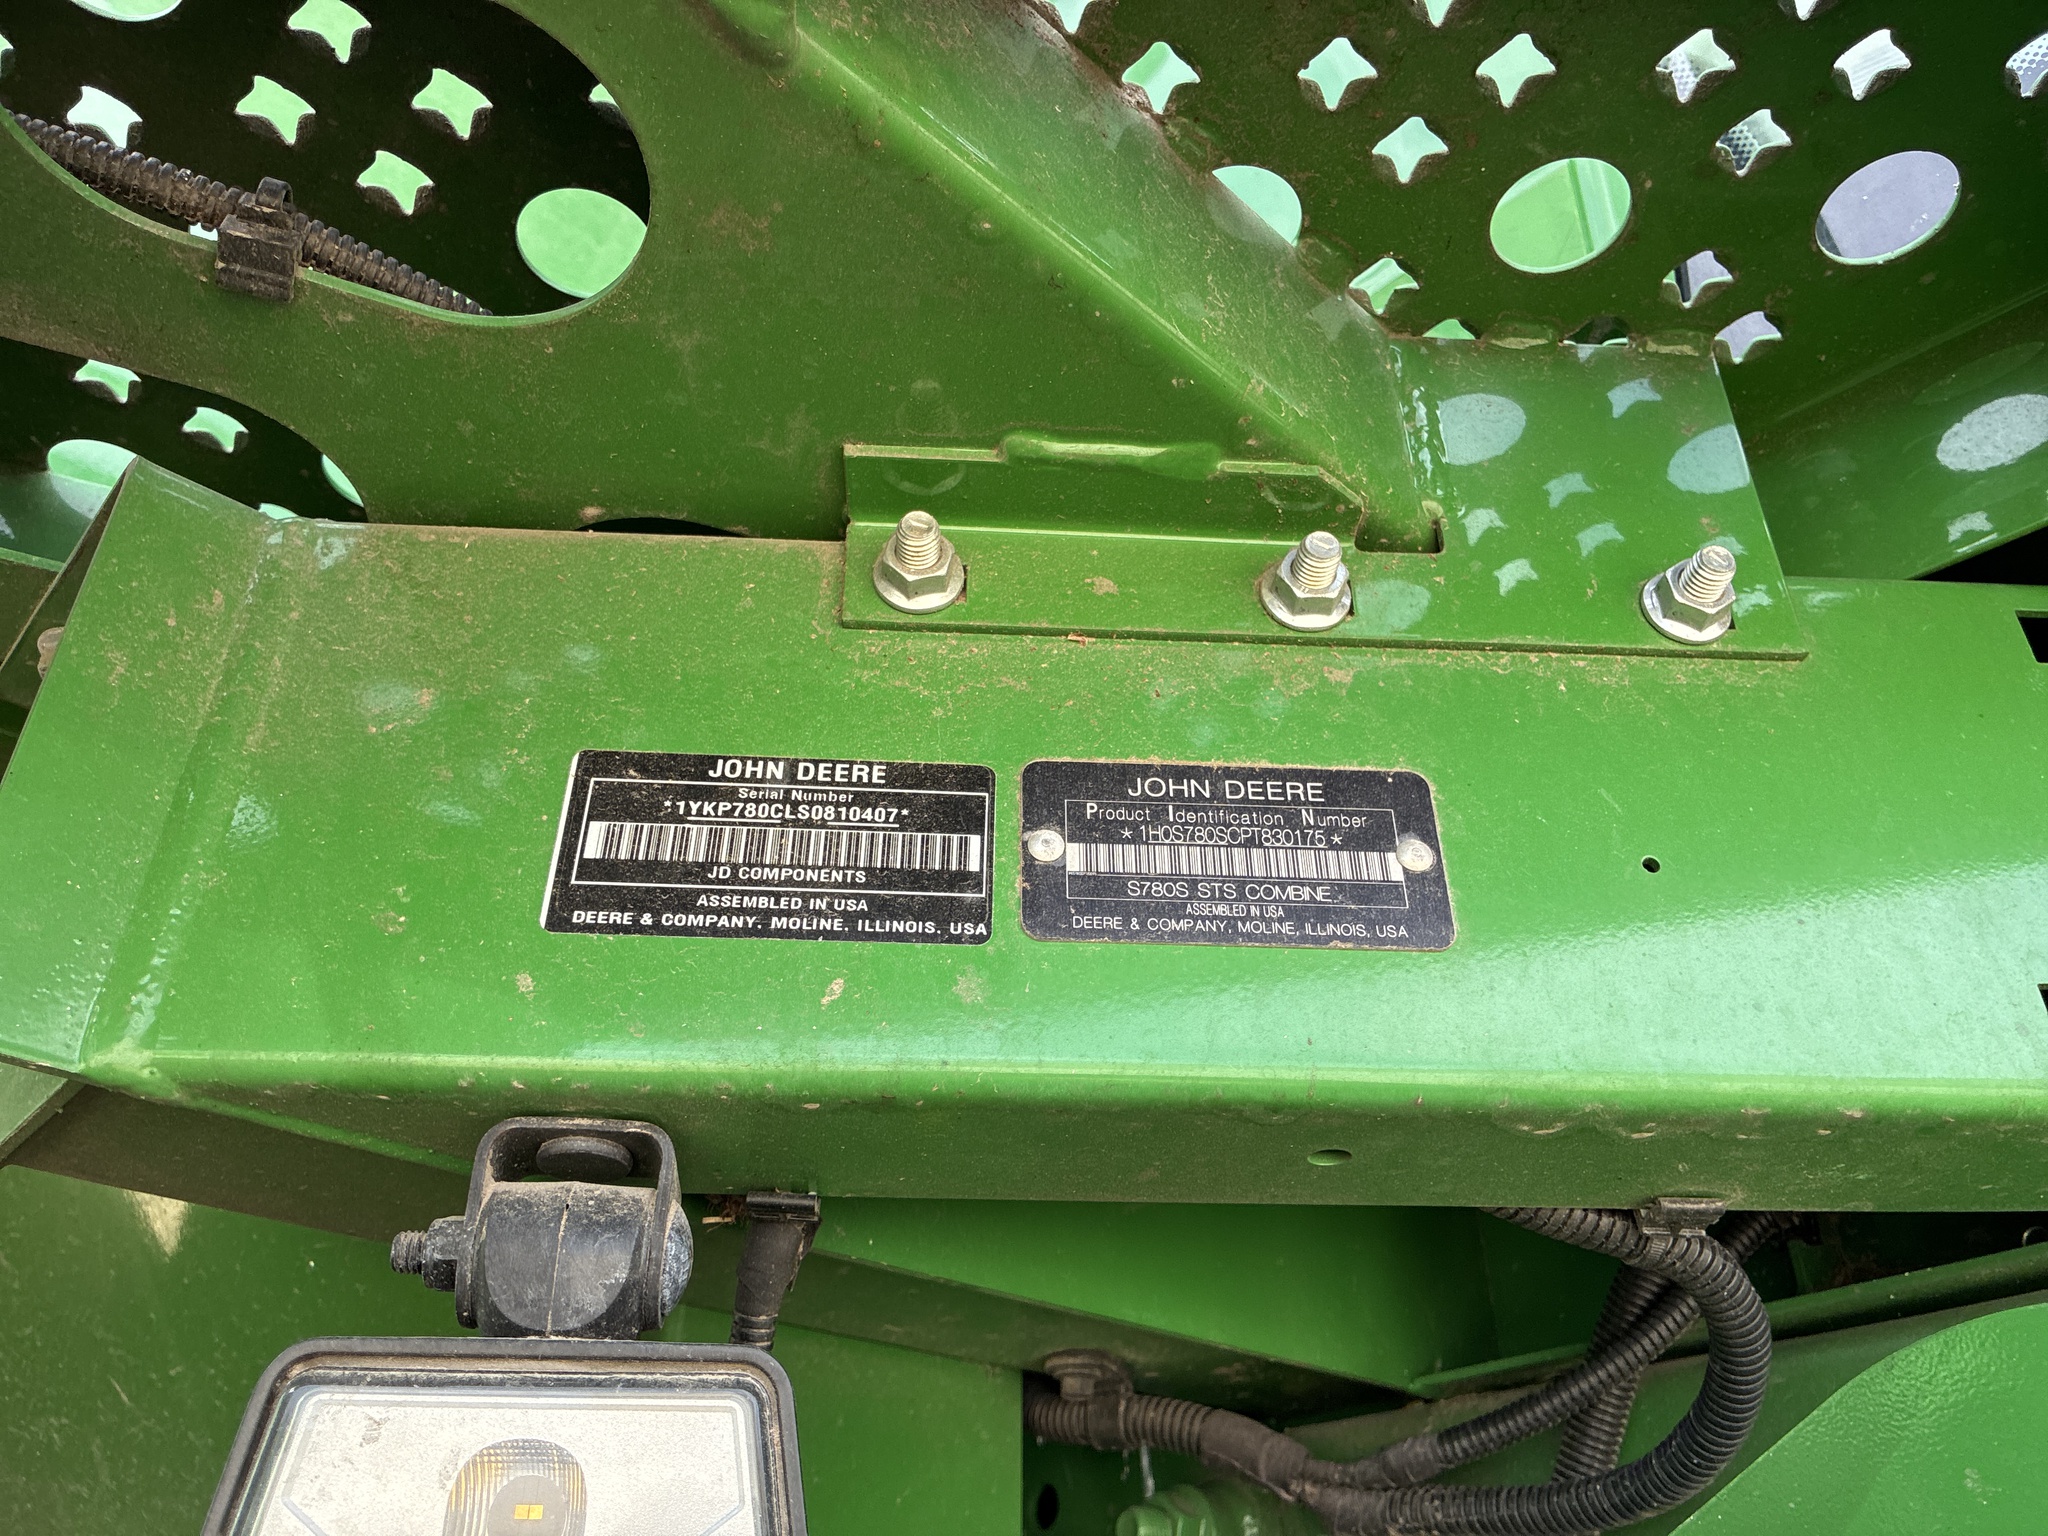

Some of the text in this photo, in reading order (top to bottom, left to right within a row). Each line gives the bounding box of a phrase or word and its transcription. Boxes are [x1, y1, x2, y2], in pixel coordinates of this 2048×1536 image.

[708, 758, 887, 784] JOHN DEERE
[738, 787, 854, 803] Serial Number
[1128, 777, 1325, 802] JOHN DEERE
[1086, 803, 1367, 828] Product Identification Number
[707, 866, 866, 884] JD COMPONENTS
[1127, 880, 1333, 902] S780S STS COMBINE
[696, 894, 868, 912] ASSEMBLED IN USA
[1186, 903, 1285, 918] ASSEMBLED IN USA
[571, 911, 633, 925] DEERE
[640, 913, 653, 926] &
[950, 923, 988, 936] USA
[1072, 916, 1123, 930] DEERE
[1130, 918, 1140, 931] &
[1376, 925, 1409, 938] USA
